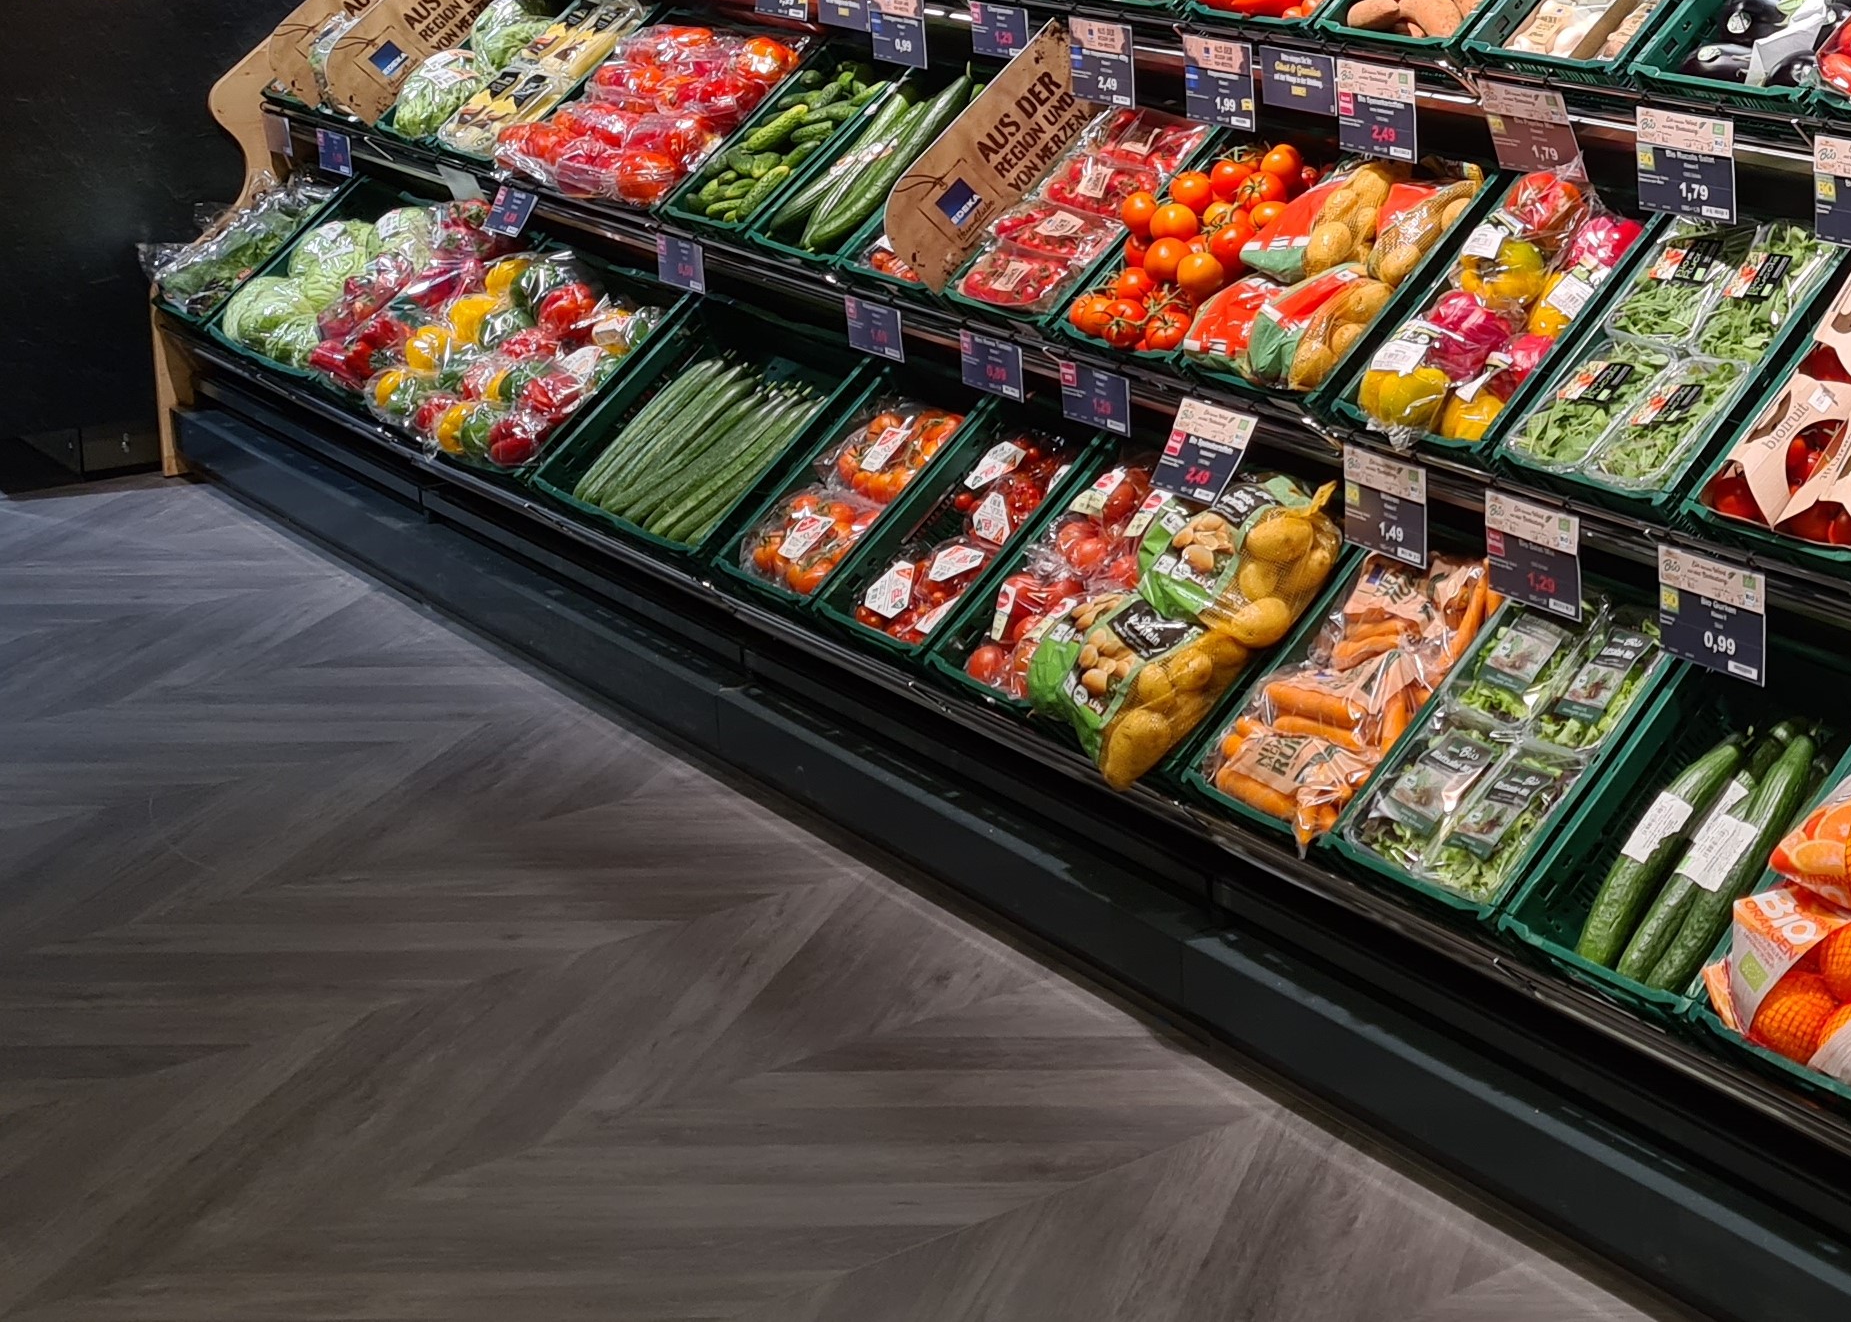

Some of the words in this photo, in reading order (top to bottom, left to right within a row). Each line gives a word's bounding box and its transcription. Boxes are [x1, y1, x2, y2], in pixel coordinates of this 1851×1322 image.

[419, 0, 464, 43] REGION
[976, 112, 1022, 164] AUS
[1015, 71, 1063, 118] DER
[993, 121, 1048, 180] REGION
[1044, 90, 1075, 127] UND
[1007, 157, 1042, 193] VON
[1036, 108, 1092, 170] HERZEN.
[1678, 181, 1709, 202] 1,79
[1761, 402, 1810, 451] biofruit
[1379, 520, 1404, 544] 1,49
[1704, 630, 1736, 656] 0,99
[1744, 899, 1799, 962] ORANGEN
[1753, 891, 1818, 946] BIO
